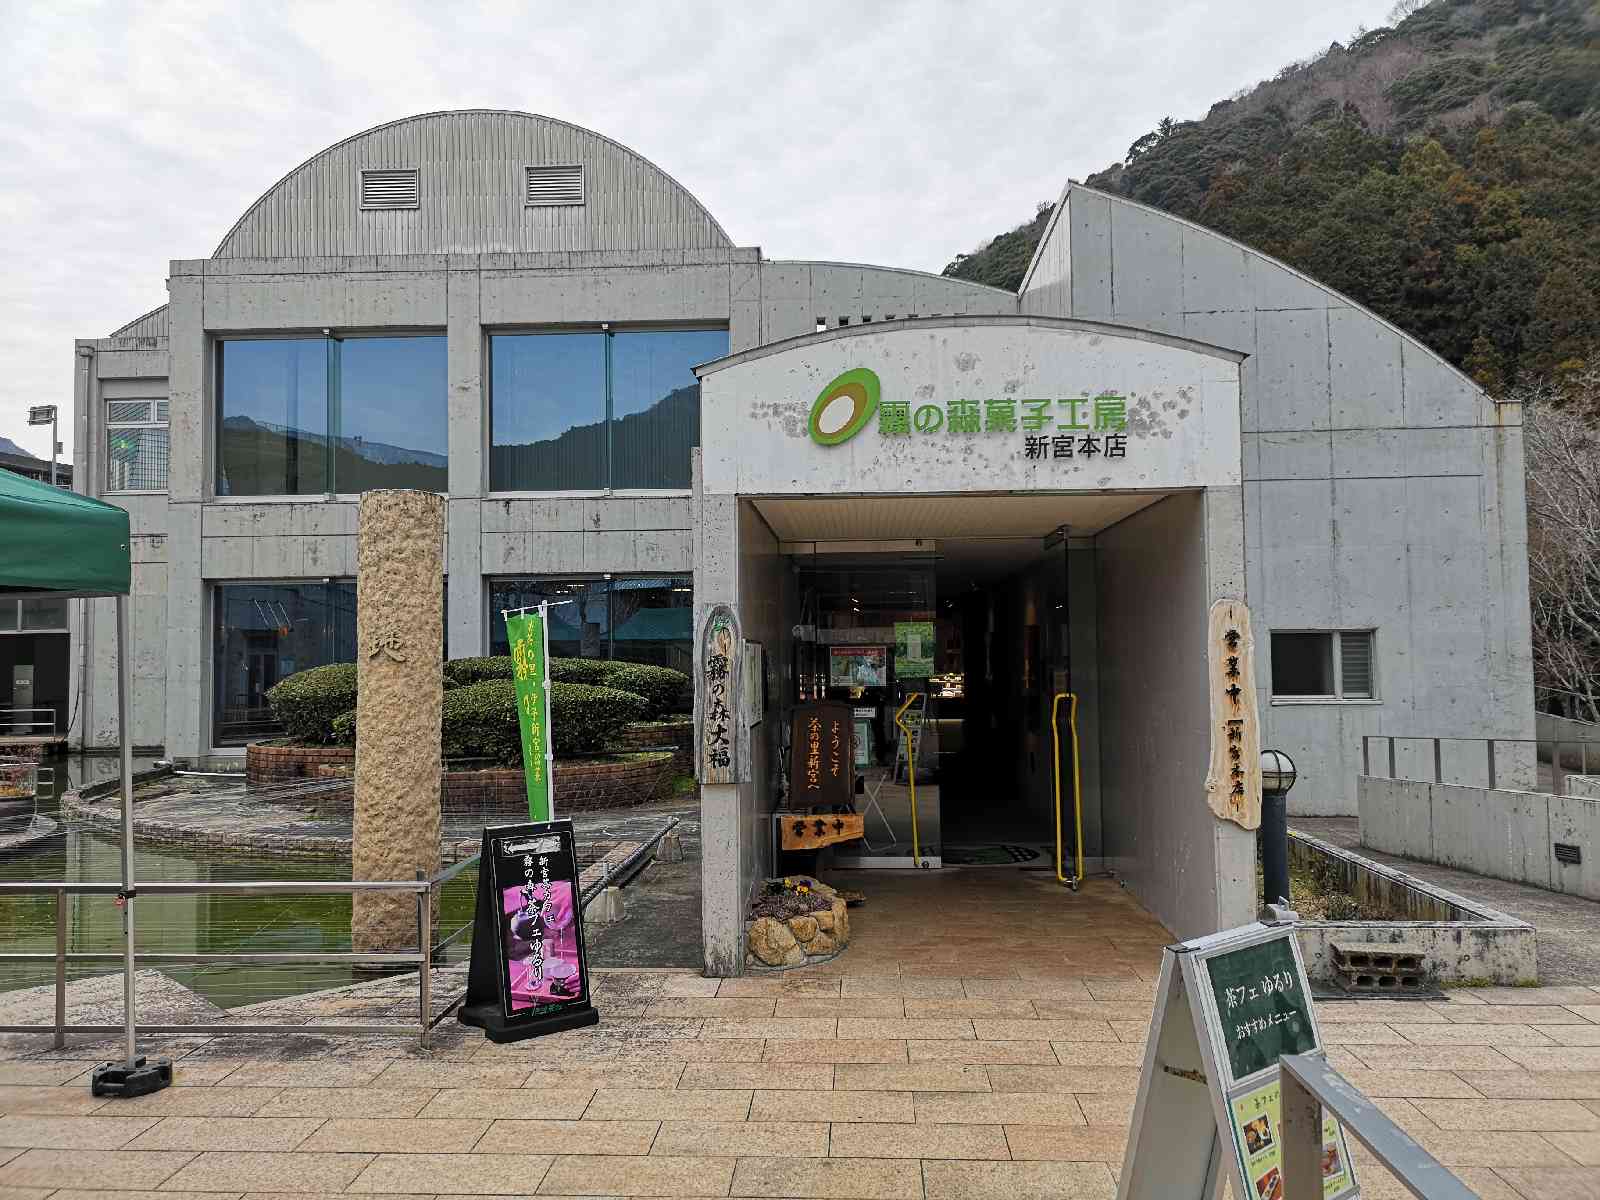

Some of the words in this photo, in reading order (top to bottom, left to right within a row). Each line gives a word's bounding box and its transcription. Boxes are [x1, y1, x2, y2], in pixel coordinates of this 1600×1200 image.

[878, 395, 1128, 434] 霧の森菓子工房
[1024, 433, 1128, 459] 新宮本店
[705, 654, 731, 769] 霧の森大福
[831, 720, 841, 777] ようこそ
[1236, 1010, 1298, 1041] おすすめメニュー
